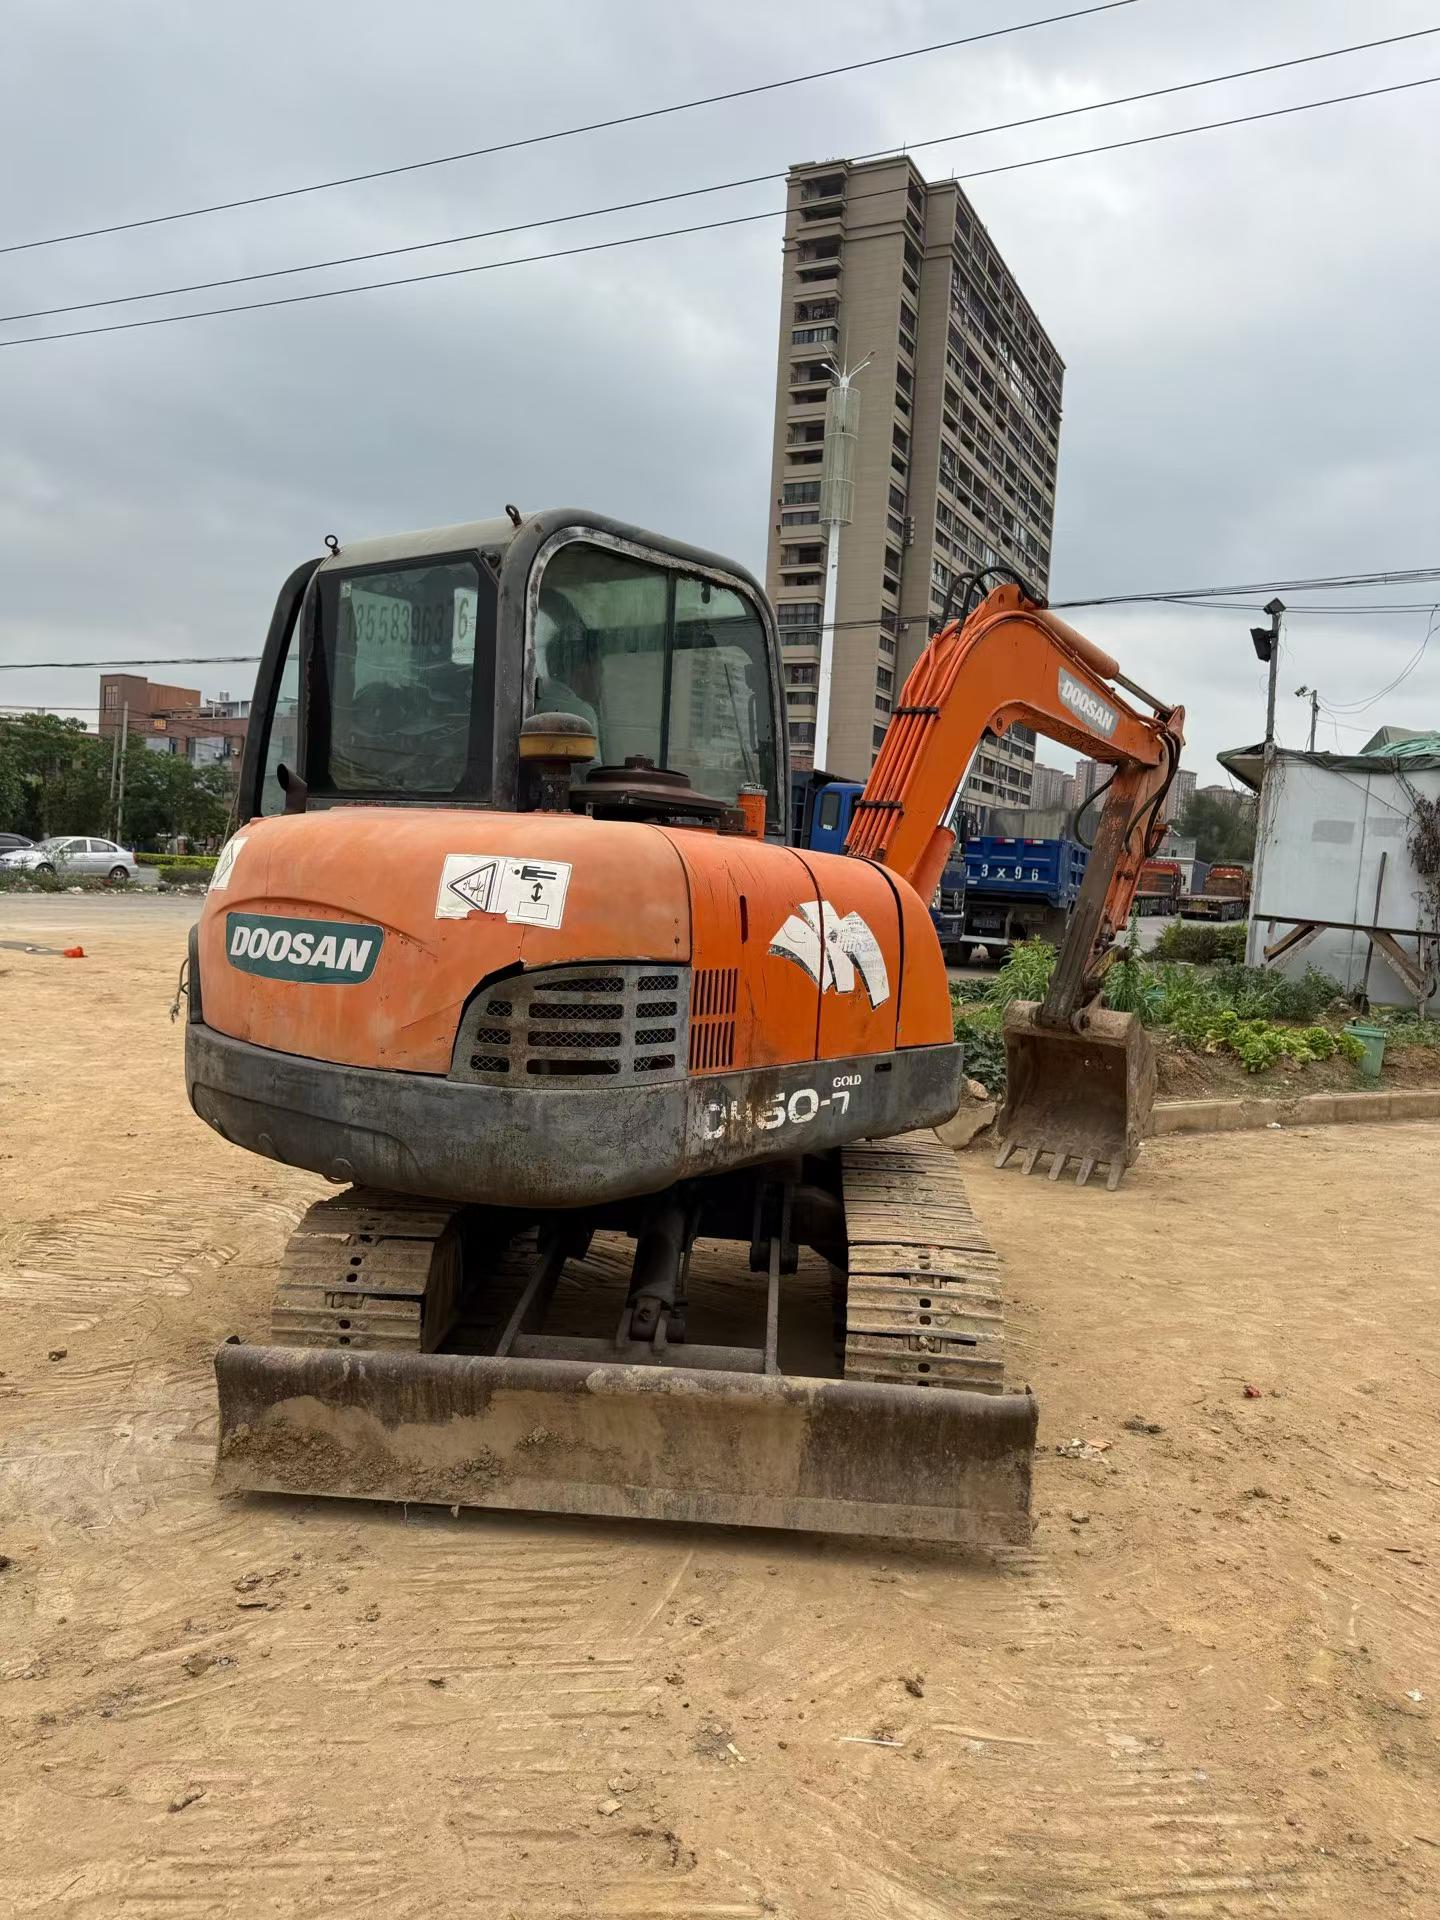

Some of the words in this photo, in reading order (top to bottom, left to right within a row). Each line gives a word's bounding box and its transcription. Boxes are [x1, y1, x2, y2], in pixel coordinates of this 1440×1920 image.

[1061, 680, 1114, 731] DOOSAN
[229, 925, 373, 973] DOOSAN
[832, 1074, 862, 1088] GOLD
